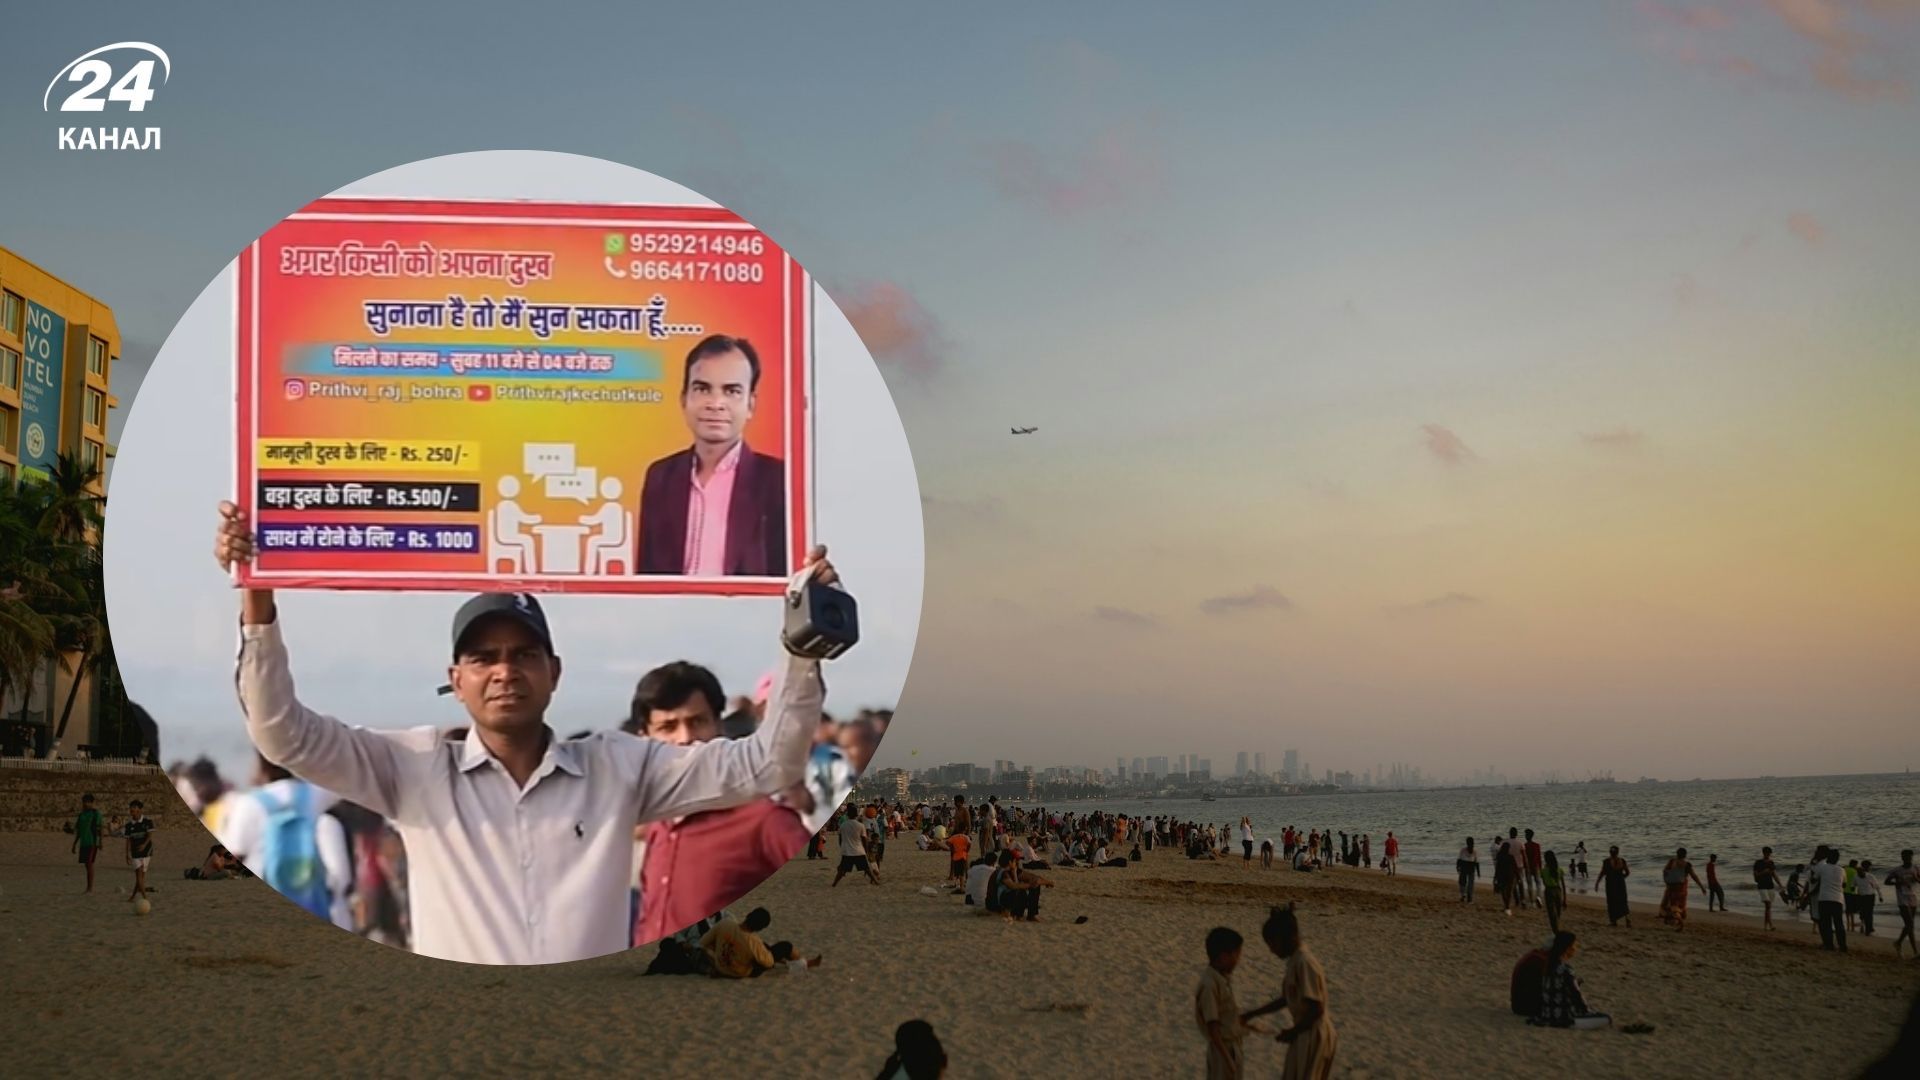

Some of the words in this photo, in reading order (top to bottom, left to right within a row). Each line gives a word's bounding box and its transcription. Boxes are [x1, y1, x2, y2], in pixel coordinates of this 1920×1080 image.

[630, 234, 764, 255] 9529214946
[281, 246, 336, 275] अगर
[339, 240, 400, 276] किसी
[404, 241, 434, 276] को
[440, 251, 504, 278] अपना
[505, 252, 553, 286] दुख
[630, 260, 764, 282] 9664171080
[26, 304, 51, 335] NO
[364, 300, 444, 334] सुनाना
[448, 295, 466, 328] है
[470, 298, 496, 328] तो
[500, 297, 526, 329] मैं
[527, 304, 570, 337] सुन
[574, 305, 643, 331] सकता
[26, 330, 50, 360] VO
[333, 344, 378, 367] मिलने
[379, 350, 399, 367] का
[400, 351, 439, 368] समय
[485, 352, 498, 369] 11
[525, 350, 540, 370] से
[542, 353, 562, 371] 04
[588, 354, 614, 372] तक
[25, 355, 54, 388] TEL
[308, 381, 464, 402] Prithvi_raj_bohra
[264, 441, 313, 465] मामूली
[315, 445, 341, 466] दुख
[342, 442, 359, 460] के
[361, 442, 388, 461] लिए
[401, 447, 421, 462] Rs.
[426, 445, 468, 465] 250/-
[293, 486, 322, 510] दुख
[324, 483, 341, 504] के
[342, 483, 374, 505] लिए
[386, 486, 459, 510] Rs.500/-
[263, 529, 298, 547] साथ
[299, 526, 317, 547] में
[317, 526, 347, 547] रोने
[347, 526, 364, 547] के
[365, 527, 396, 547] लिए
[408, 530, 432, 548] Rs.
[436, 530, 473, 549] 1000
